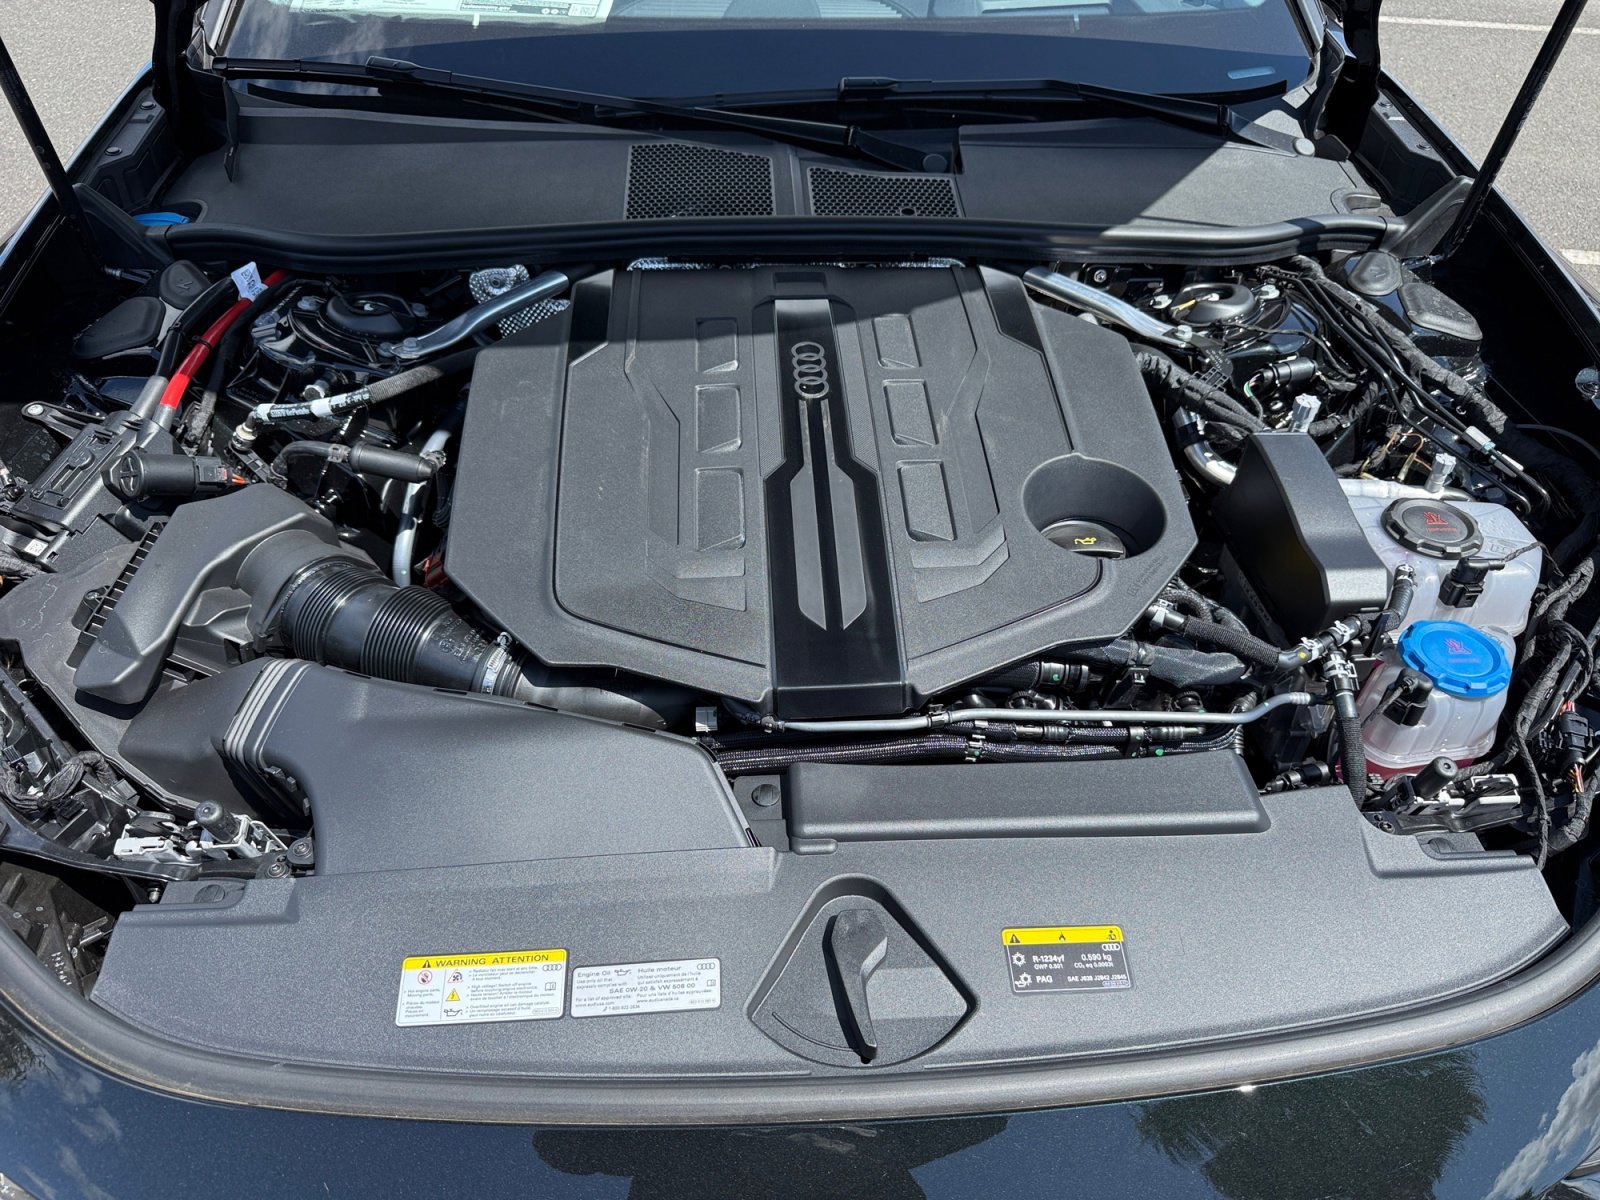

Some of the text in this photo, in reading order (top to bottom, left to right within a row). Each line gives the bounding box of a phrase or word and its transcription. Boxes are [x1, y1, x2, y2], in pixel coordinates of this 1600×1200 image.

[435, 954, 549, 967] WARNING ATTENTION
[1032, 954, 1064, 963] R-1234yf
[1081, 953, 1112, 962] 0.590 kg
[1036, 975, 1053, 983] PAG
